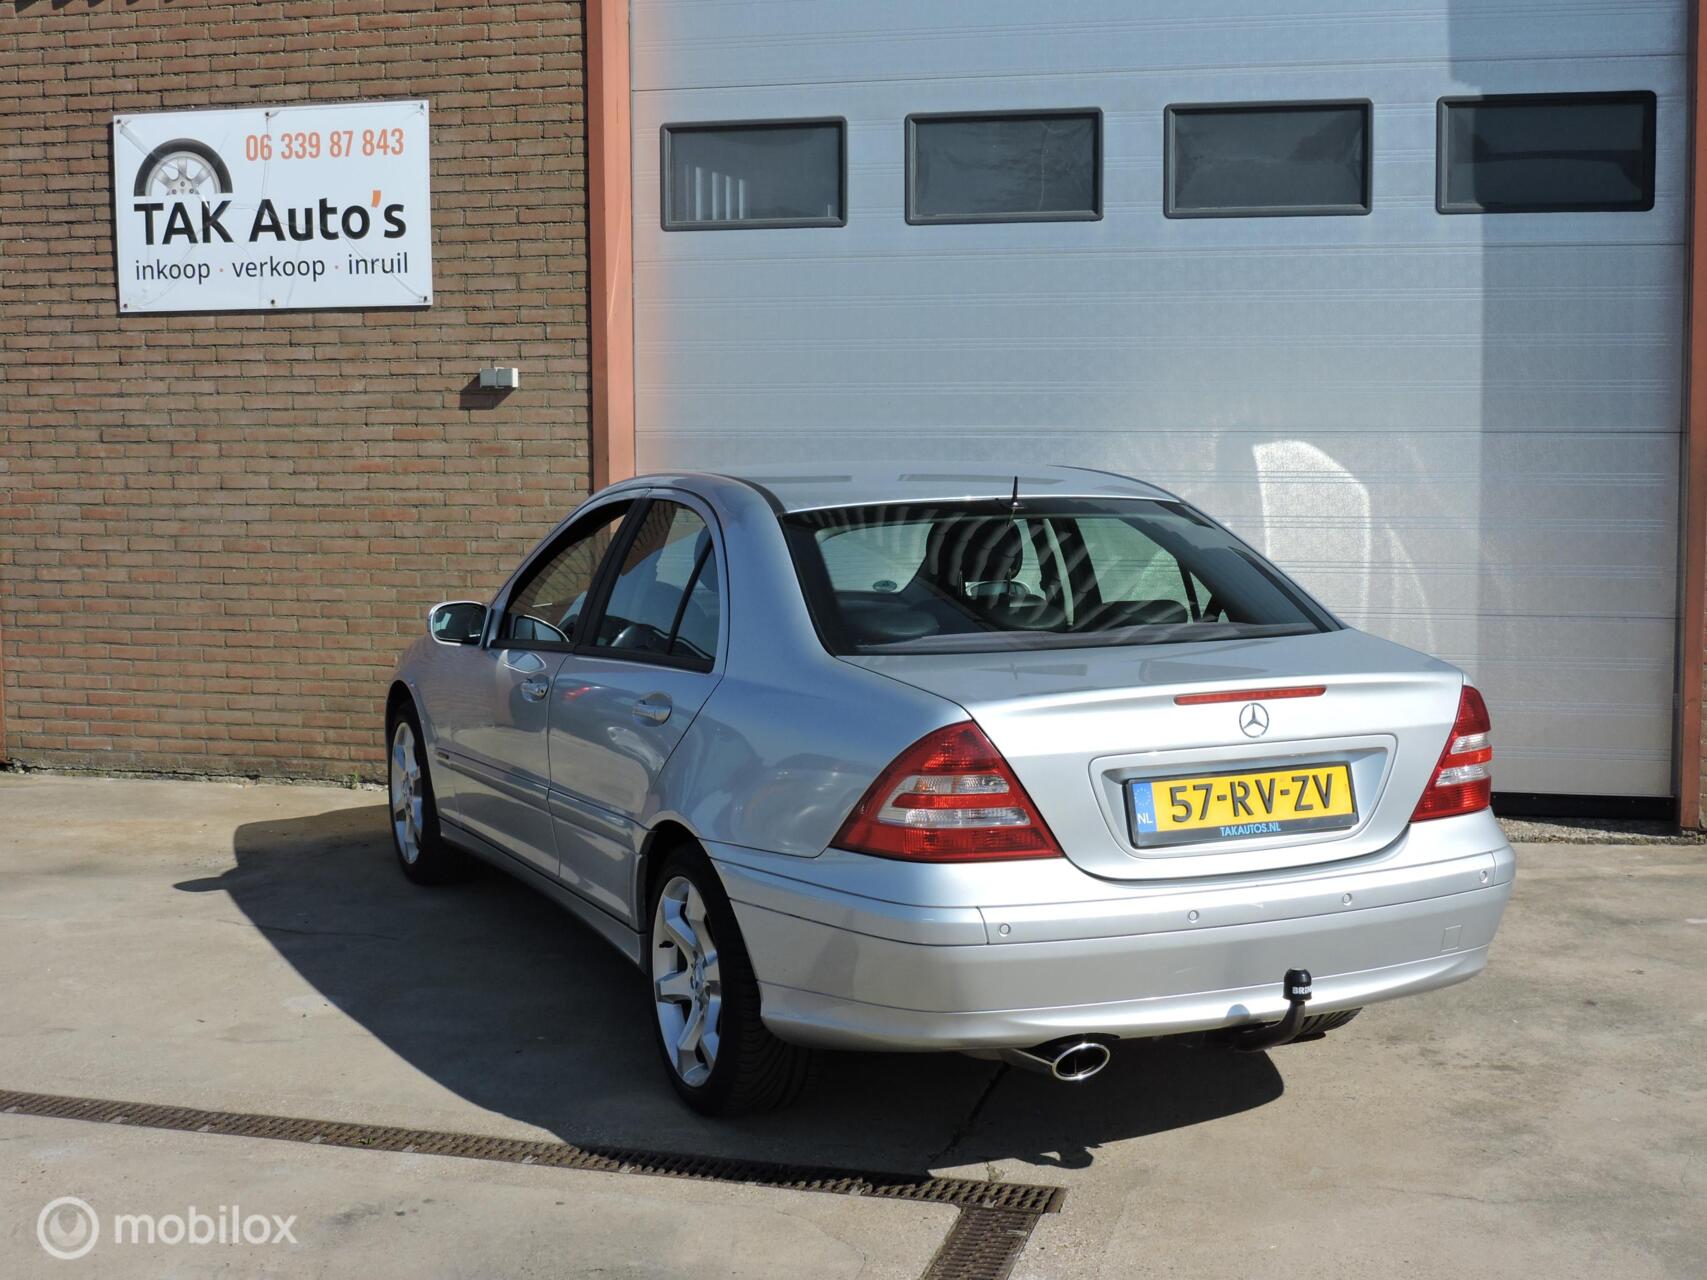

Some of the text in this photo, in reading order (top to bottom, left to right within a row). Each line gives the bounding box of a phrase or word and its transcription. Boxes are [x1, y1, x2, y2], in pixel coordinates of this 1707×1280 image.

[245, 127, 404, 161] 06 339 87 843
[133, 190, 407, 245] TAK Auto's
[135, 252, 409, 284] inkoop verkoop inruil
[1169, 773, 1333, 823] 57-RV-ZV
[1137, 813, 1153, 825] NL
[1220, 823, 1281, 837] TAKAUTOS.NL
